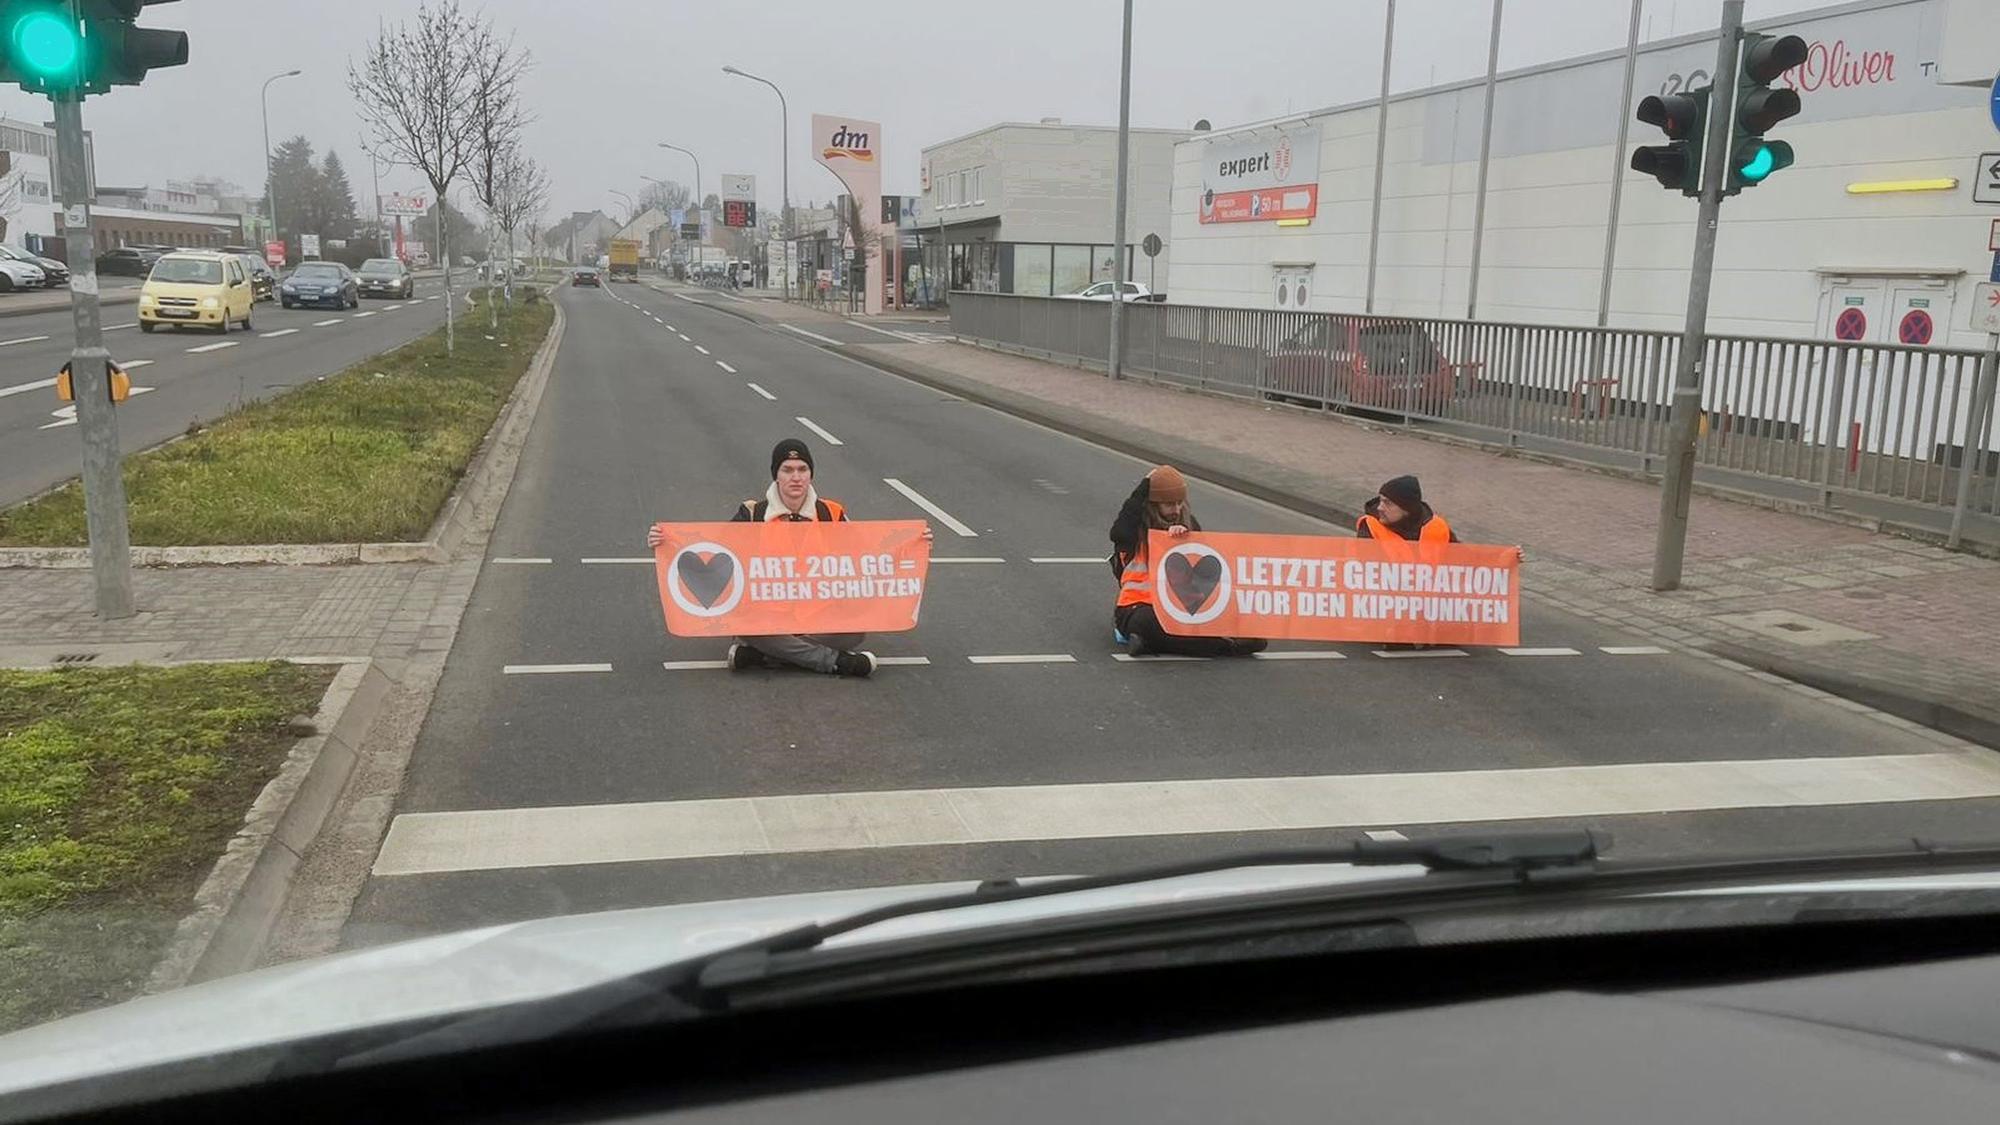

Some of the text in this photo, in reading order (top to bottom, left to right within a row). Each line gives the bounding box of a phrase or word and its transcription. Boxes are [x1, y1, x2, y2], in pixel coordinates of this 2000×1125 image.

[831, 125, 869, 149] dm
[1220, 152, 1269, 178] expert
[750, 556, 800, 578] ART.
[807, 557, 855, 577] 20A
[860, 554, 894, 576] GG
[1237, 556, 1509, 595] LETZTE GENERATION
[750, 577, 920, 600] LEBEN SCHÜTZEN
[1237, 590, 1509, 624] VOR DEN KIPPPUNKTEN
